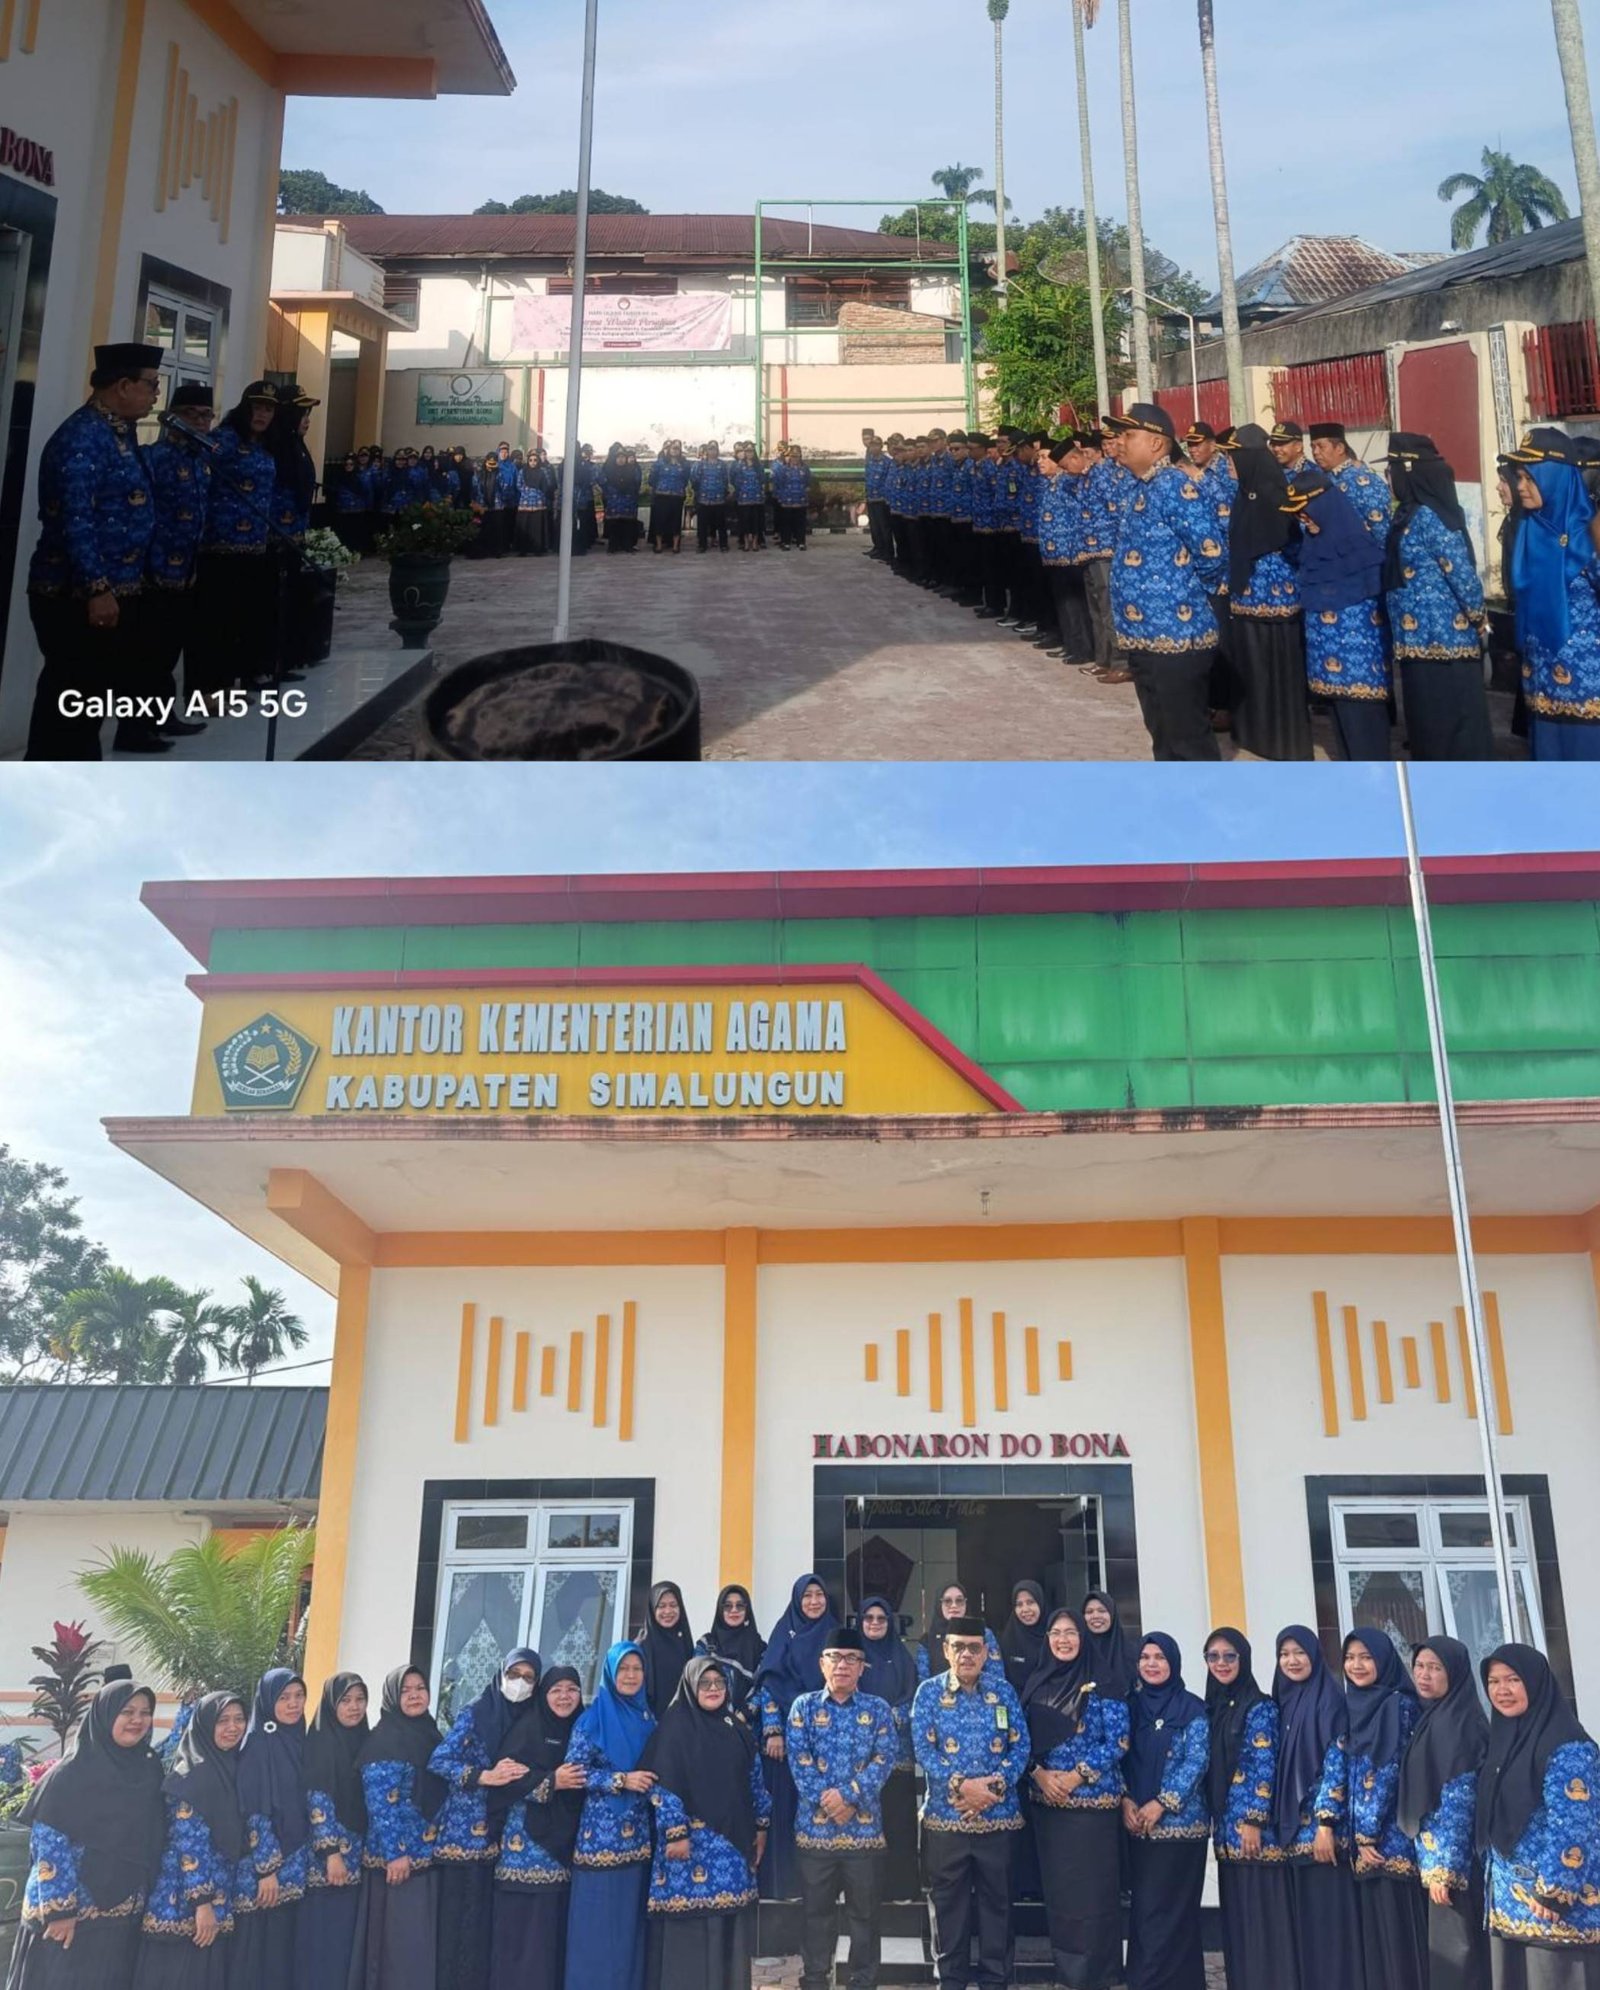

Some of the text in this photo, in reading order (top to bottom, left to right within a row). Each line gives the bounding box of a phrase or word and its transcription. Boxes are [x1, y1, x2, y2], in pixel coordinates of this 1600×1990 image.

[331, 1000, 847, 1056] KANTOR KEMENTERIAN AGAMA
[326, 1071, 844, 1110] KABUPATEN SIMALUNGUN
[813, 1433, 1130, 1458] HABONARON DO BONA
